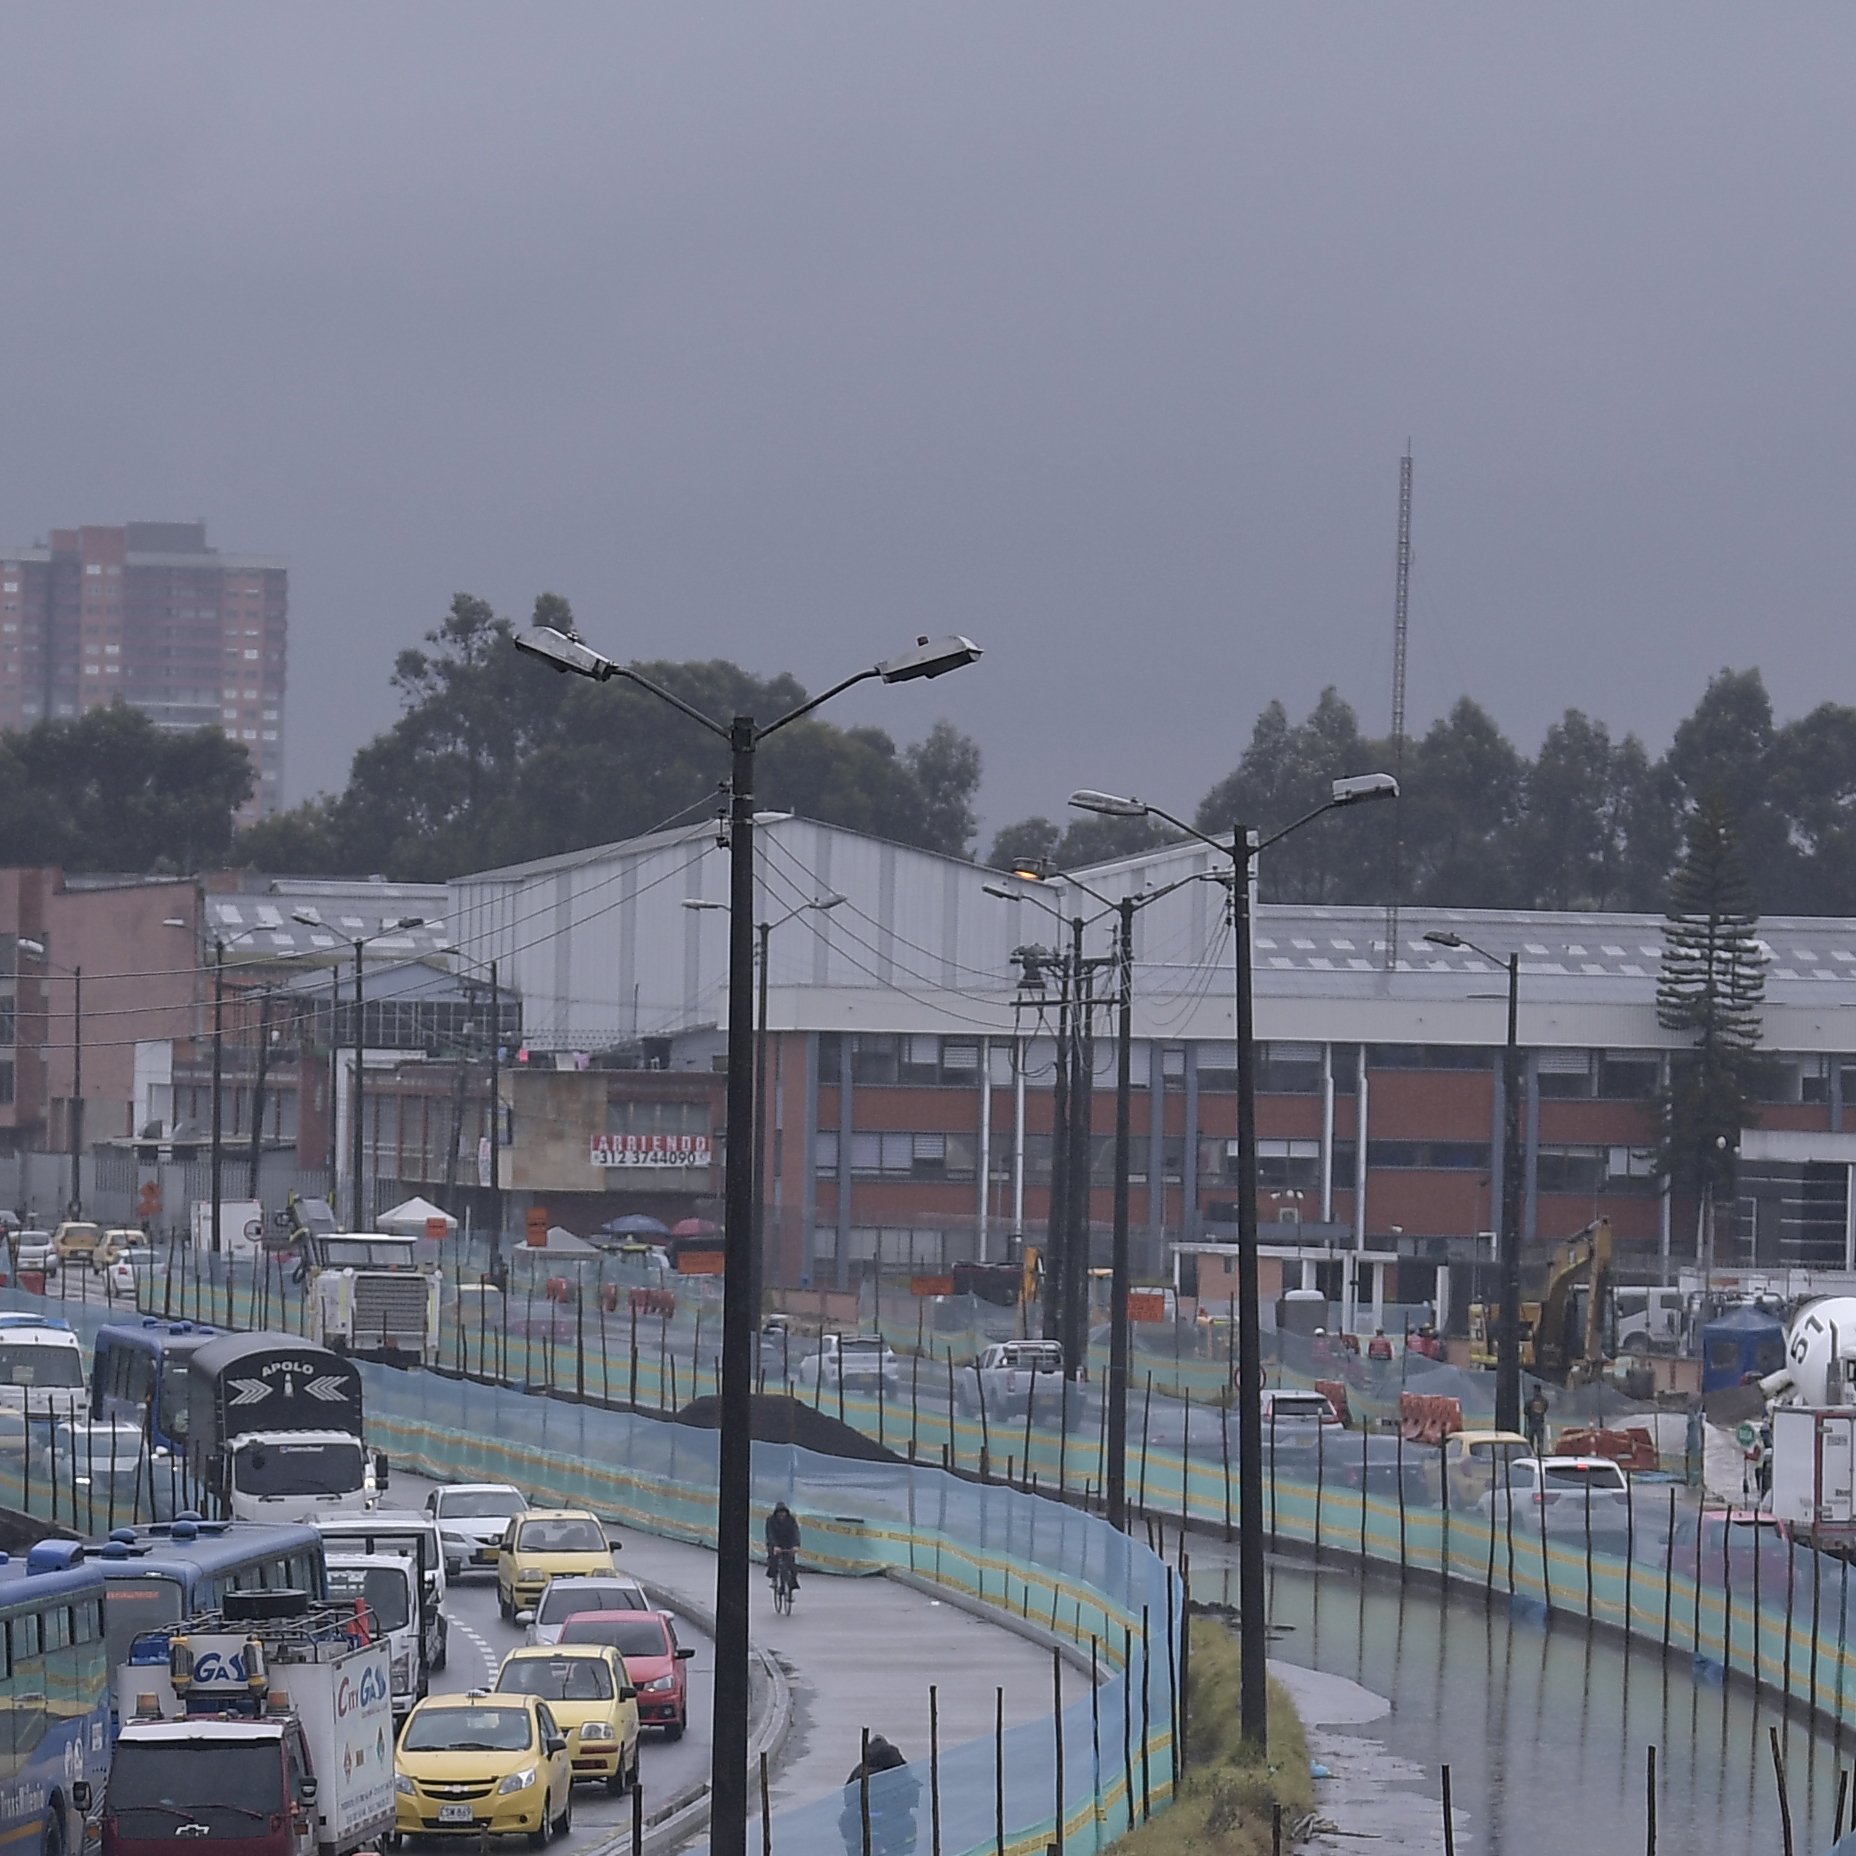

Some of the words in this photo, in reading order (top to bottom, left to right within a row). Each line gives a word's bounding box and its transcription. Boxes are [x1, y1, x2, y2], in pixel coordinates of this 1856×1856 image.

[598, 1135, 706, 1151] ARRIENDO
[600, 1152, 626, 1164] 312
[632, 1151, 696, 1164] 3744090
[262, 1361, 315, 1377] APOLO
